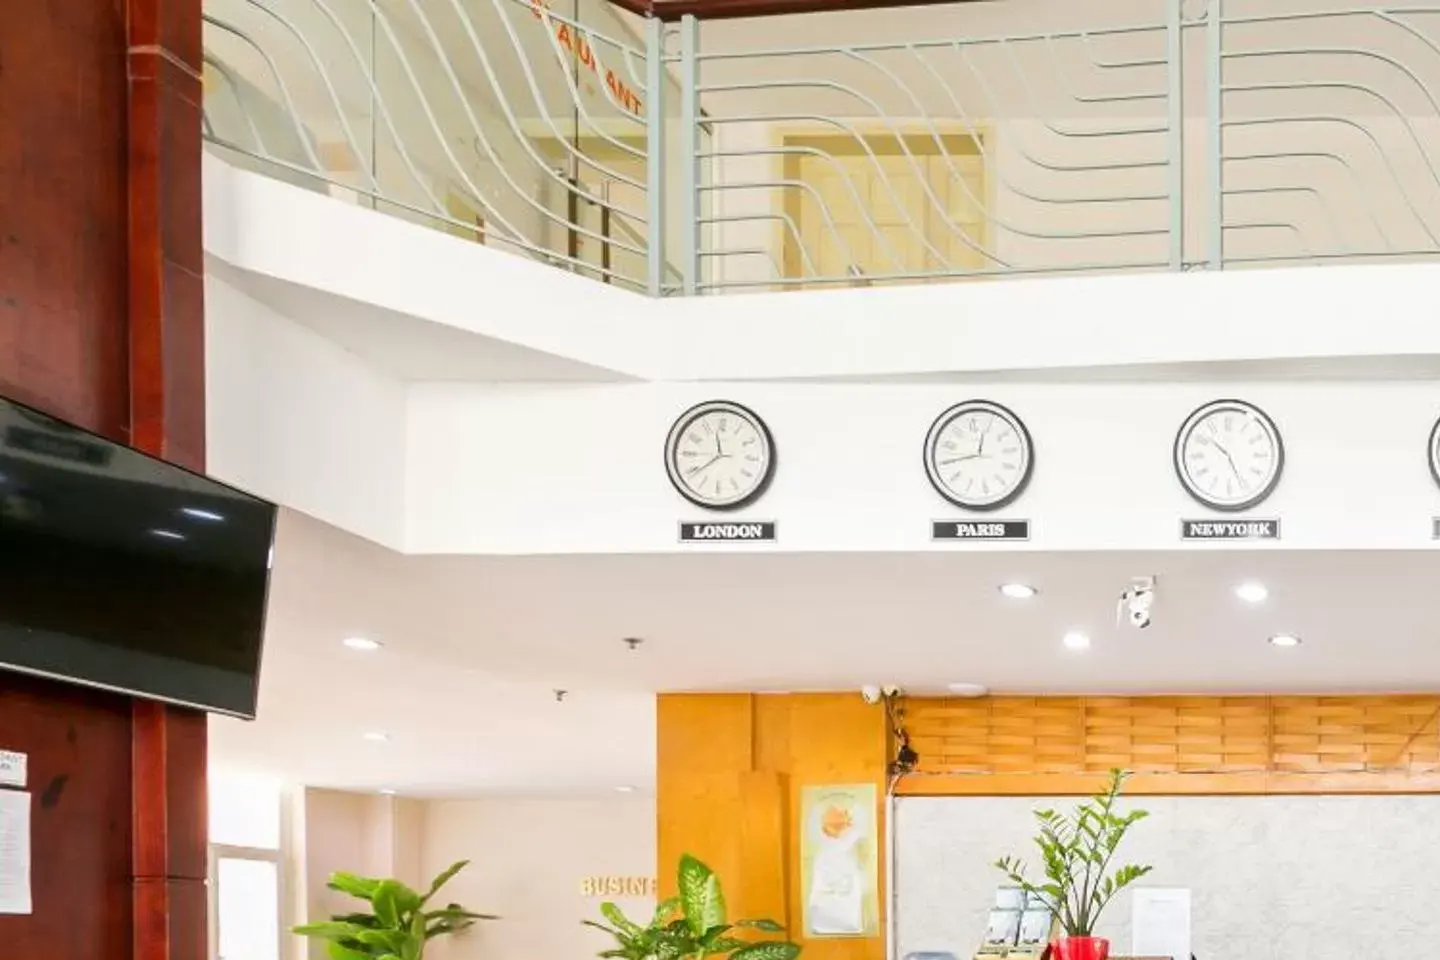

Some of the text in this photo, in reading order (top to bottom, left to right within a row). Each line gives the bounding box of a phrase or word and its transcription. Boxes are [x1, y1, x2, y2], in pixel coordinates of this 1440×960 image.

[692, 524, 763, 539] LONDON
[955, 523, 1005, 537] PARIS
[1190, 522, 1271, 537] NEWYORK
